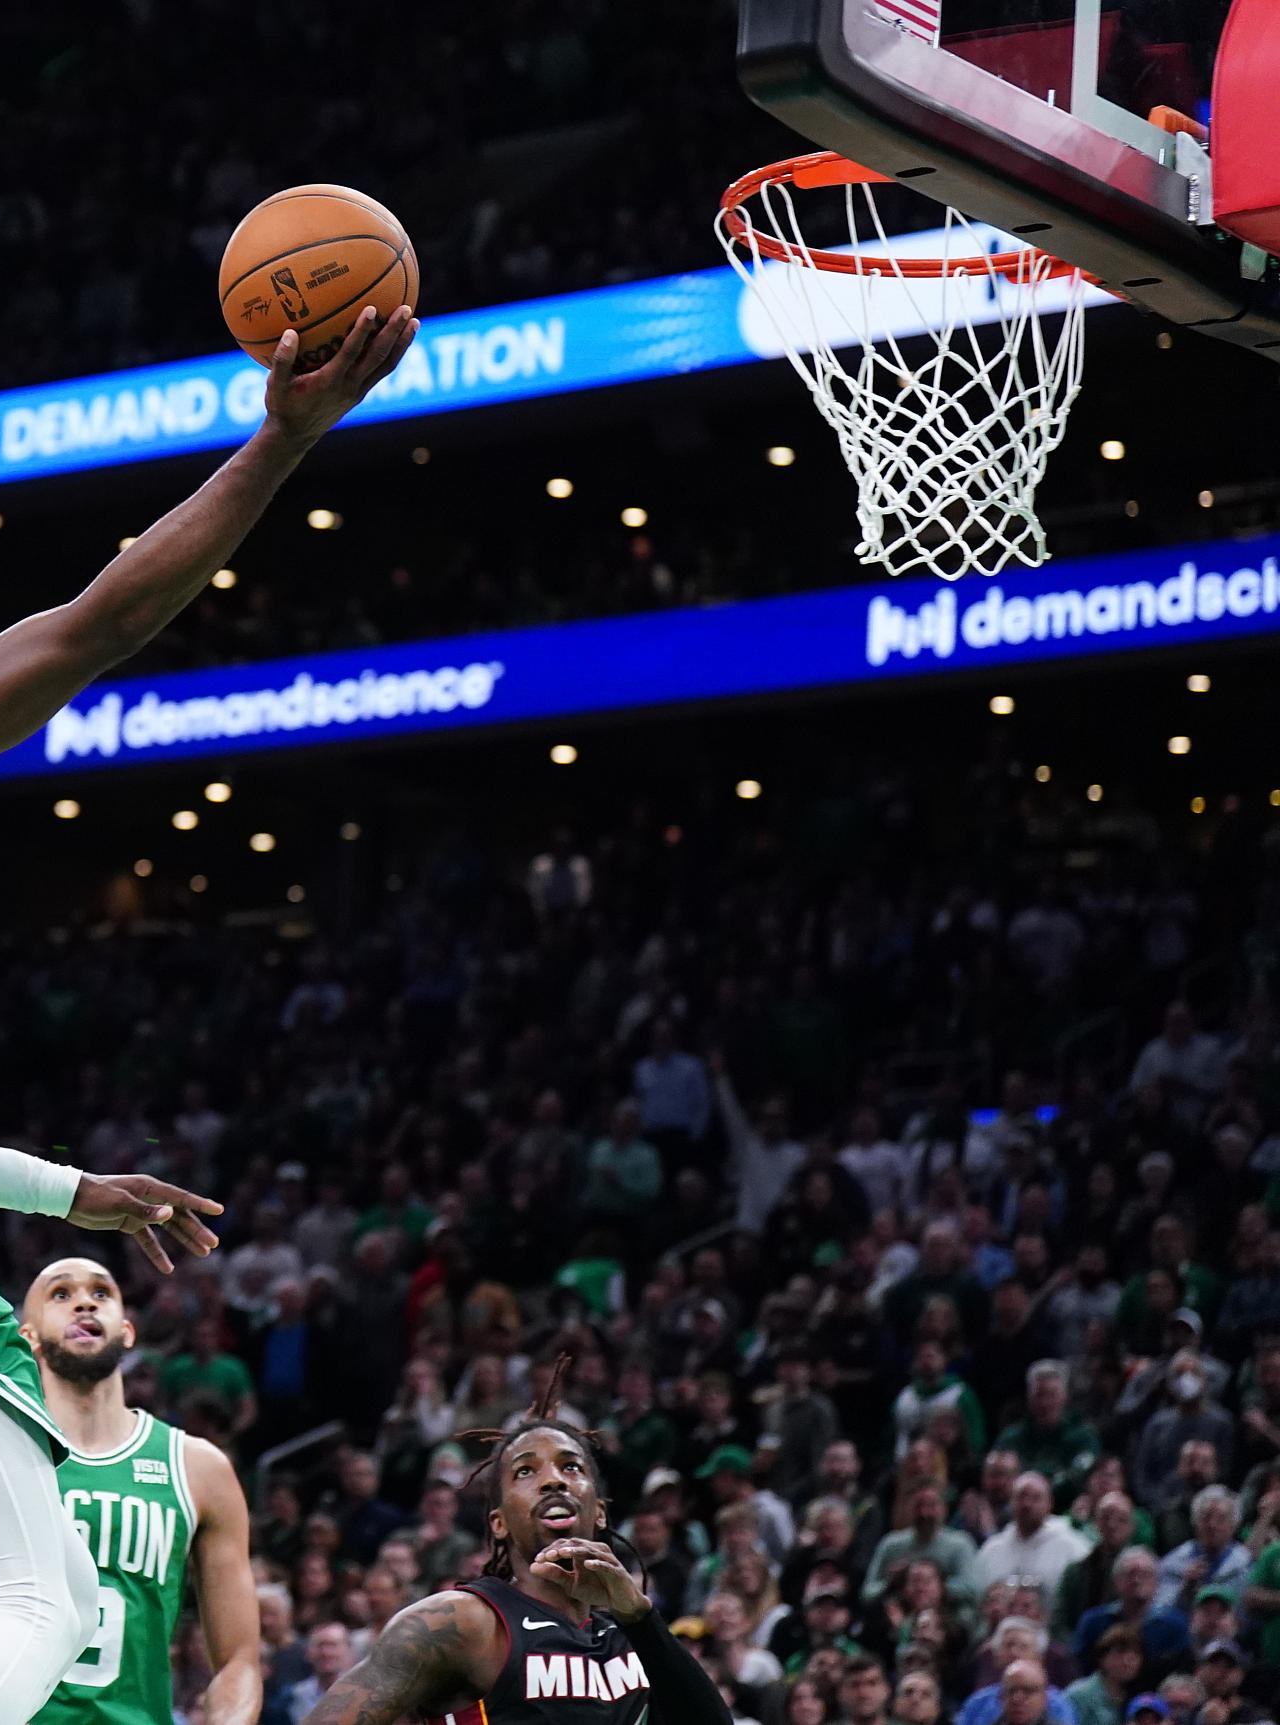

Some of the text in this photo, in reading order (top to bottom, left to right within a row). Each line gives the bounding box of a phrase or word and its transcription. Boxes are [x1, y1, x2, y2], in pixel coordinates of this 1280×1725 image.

[1, 376, 219, 461] DEMAND
[225, 317, 566, 425] GATION
[963, 557, 1280, 647] demandsci
[123, 663, 497, 748] demandscience
[64, 1489, 177, 1586] STON
[525, 1651, 651, 1701] MIAM
